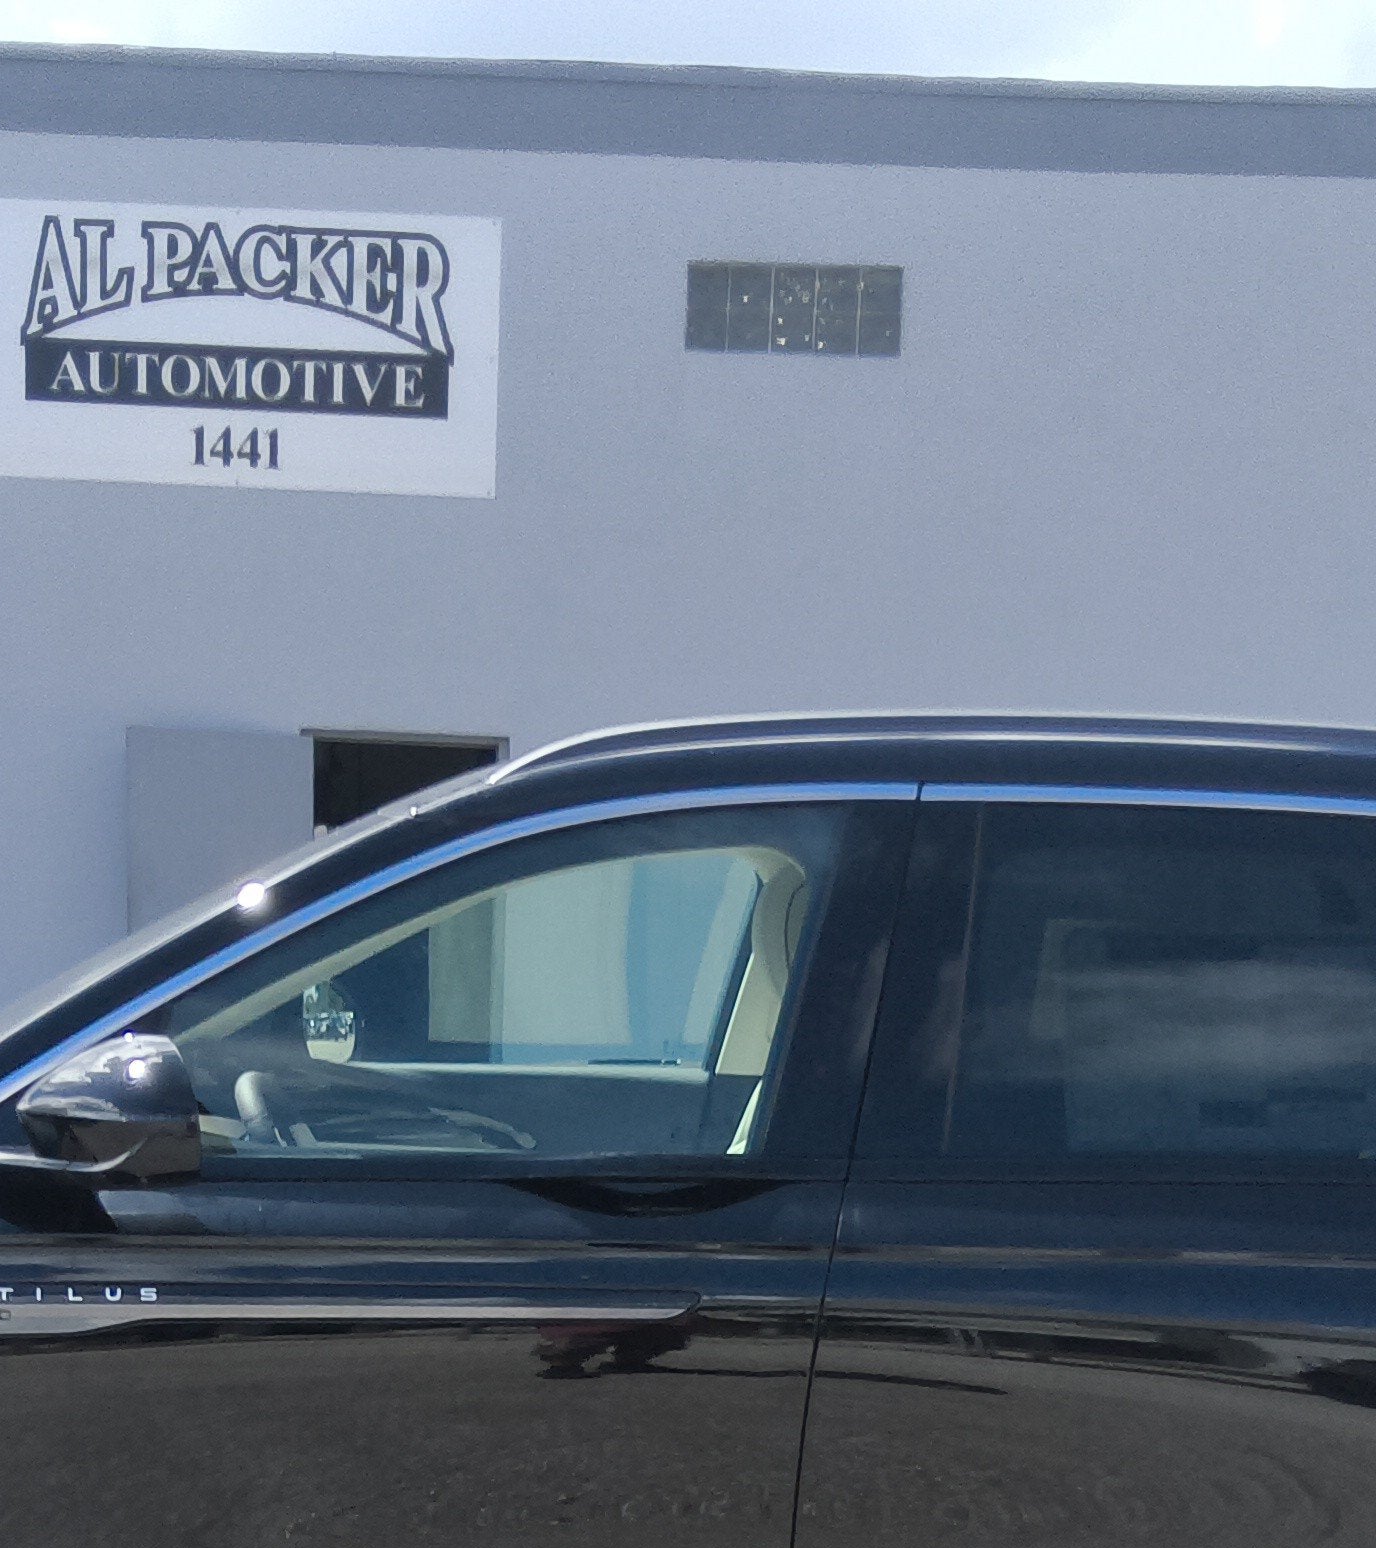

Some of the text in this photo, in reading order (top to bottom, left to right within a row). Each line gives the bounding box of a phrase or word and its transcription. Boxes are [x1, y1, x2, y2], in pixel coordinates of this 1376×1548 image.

[22, 215, 453, 362] AL PACKER
[49, 350, 426, 408] AUTOMOTIVE
[192, 425, 280, 470] 1441
